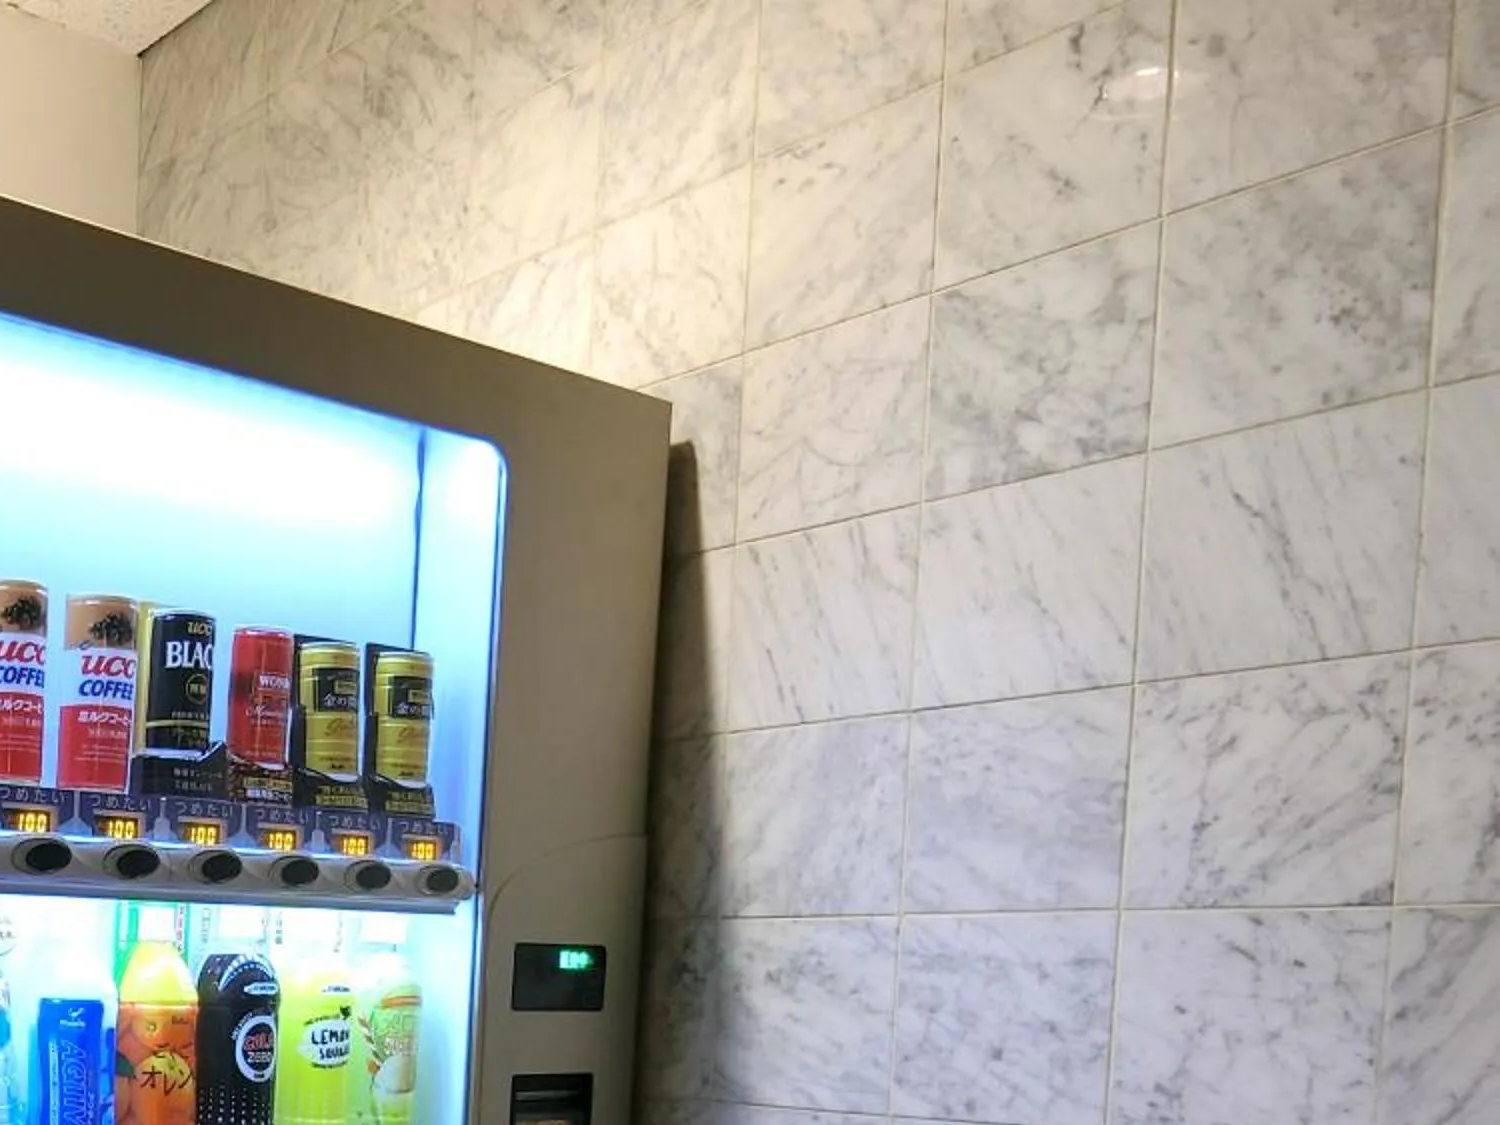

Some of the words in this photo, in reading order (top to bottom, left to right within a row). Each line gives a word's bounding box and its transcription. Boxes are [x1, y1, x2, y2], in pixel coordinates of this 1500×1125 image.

[18, 813, 47, 832] 100
[108, 820, 135, 839] 100
[191, 826, 216, 845] 100
[269, 833, 293, 852] 100
[342, 838, 365, 857] 100
[412, 843, 434, 862] 100
